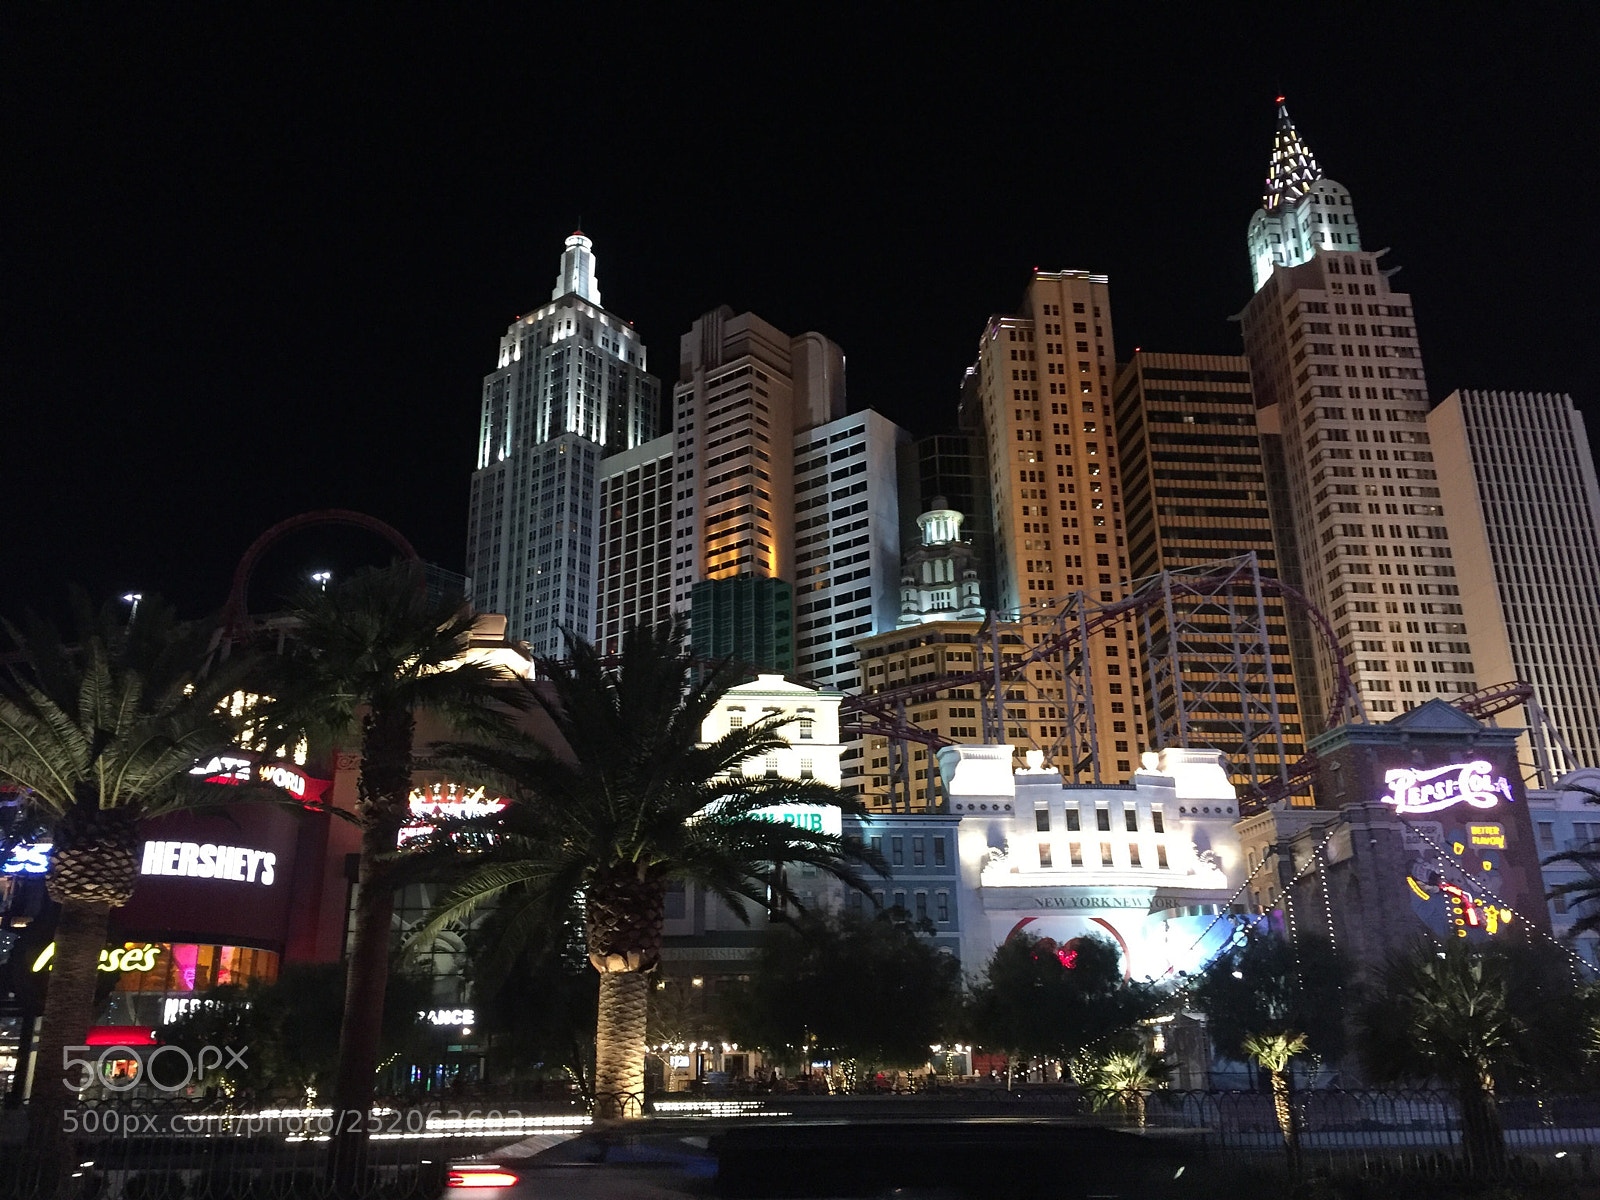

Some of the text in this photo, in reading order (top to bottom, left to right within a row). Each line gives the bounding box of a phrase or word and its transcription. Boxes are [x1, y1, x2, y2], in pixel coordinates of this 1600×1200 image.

[141, 841, 276, 885] HERSHEY'S
[1034, 897, 1181, 909] NEW YORK NEW YORK
[32, 941, 161, 972] se's
